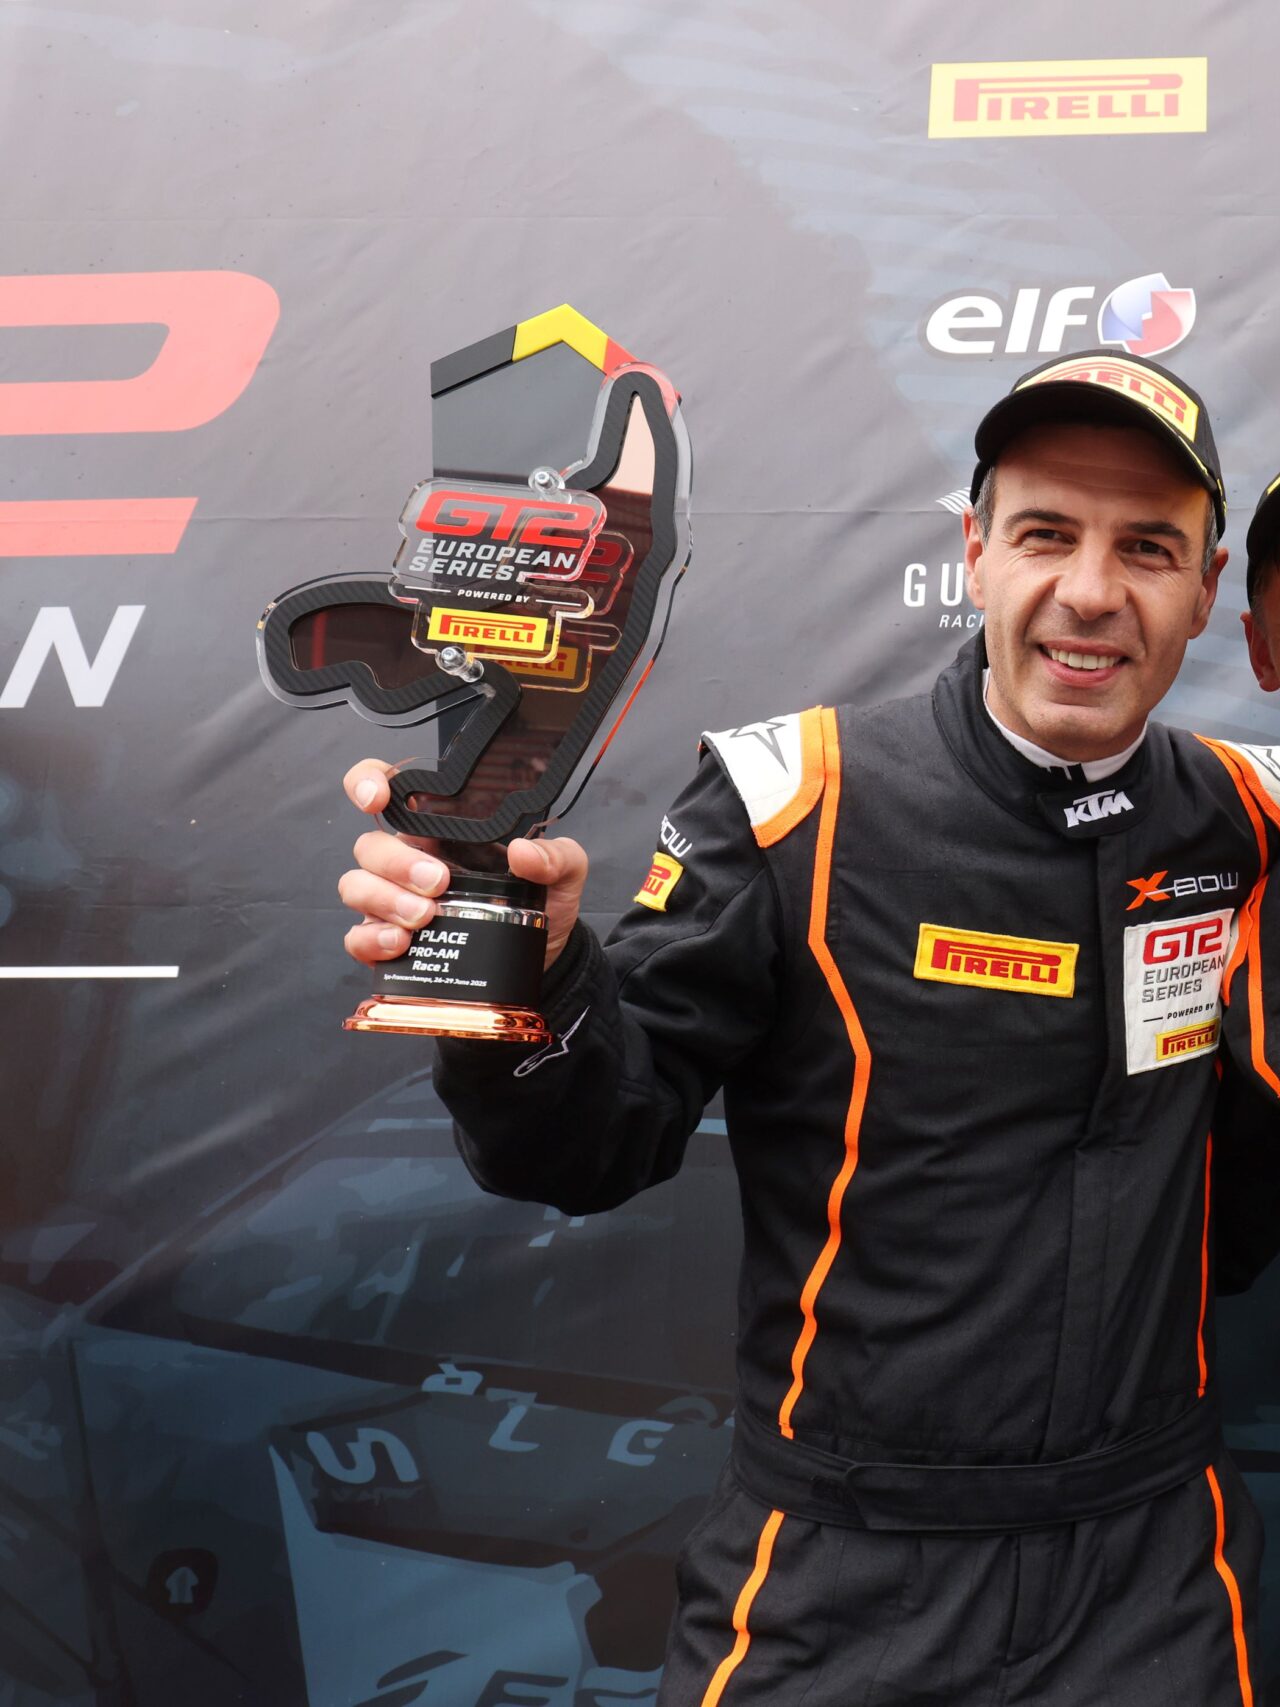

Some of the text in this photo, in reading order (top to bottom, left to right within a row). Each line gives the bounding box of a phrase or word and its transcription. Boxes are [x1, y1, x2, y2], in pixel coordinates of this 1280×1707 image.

[953, 73, 1183, 122] PIRELLI
[925, 286, 1096, 354] elf
[415, 490, 597, 549] GT2
[408, 555, 515, 581] SERIES
[416, 538, 577, 569] EUROPEAN
[457, 588, 530, 604] POWERED BY
[438, 614, 537, 644] PIRELLI
[1063, 789, 1135, 828] KTM
[419, 929, 470, 945] PLACE
[1143, 917, 1224, 965] GT2
[408, 946, 460, 960] PRO-AM
[411, 960, 450, 973] Race 1
[930, 938, 1062, 985] PIRELLI
[1143, 953, 1226, 986] EUROPEAN
[1142, 978, 1202, 1004] SERIES
[1166, 1002, 1215, 1020] POWERED BY
[1162, 1024, 1216, 1056] PIRELLI
